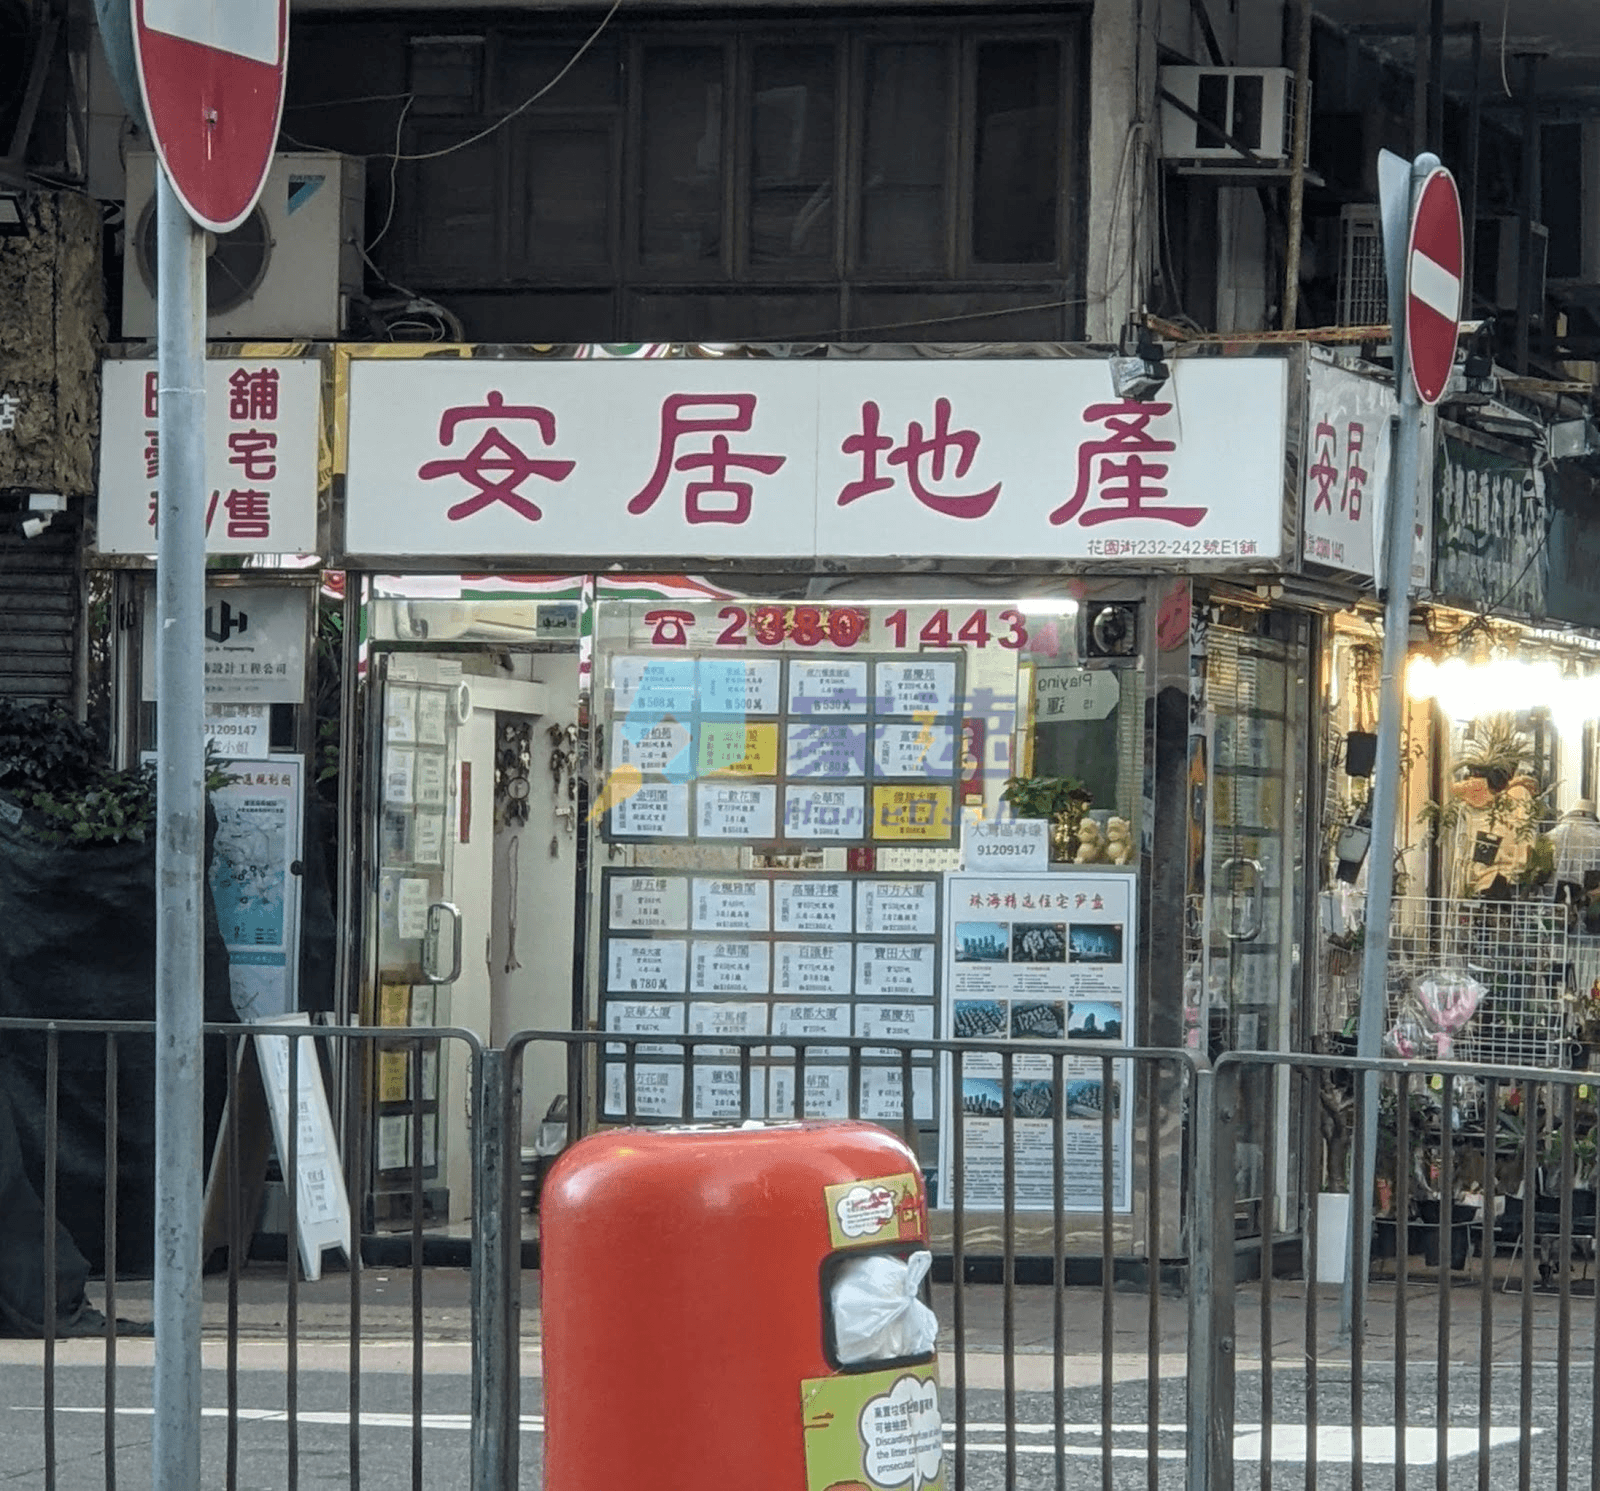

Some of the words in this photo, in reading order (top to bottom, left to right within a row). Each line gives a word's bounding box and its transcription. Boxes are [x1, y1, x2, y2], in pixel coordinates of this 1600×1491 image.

[419, 389, 1207, 528] 安居地產
[1310, 412, 1368, 521] 安居
[885, 609, 1028, 649] 1443
[977, 844, 1036, 856] 91209147
[631, 978, 667, 990] 售780萬
